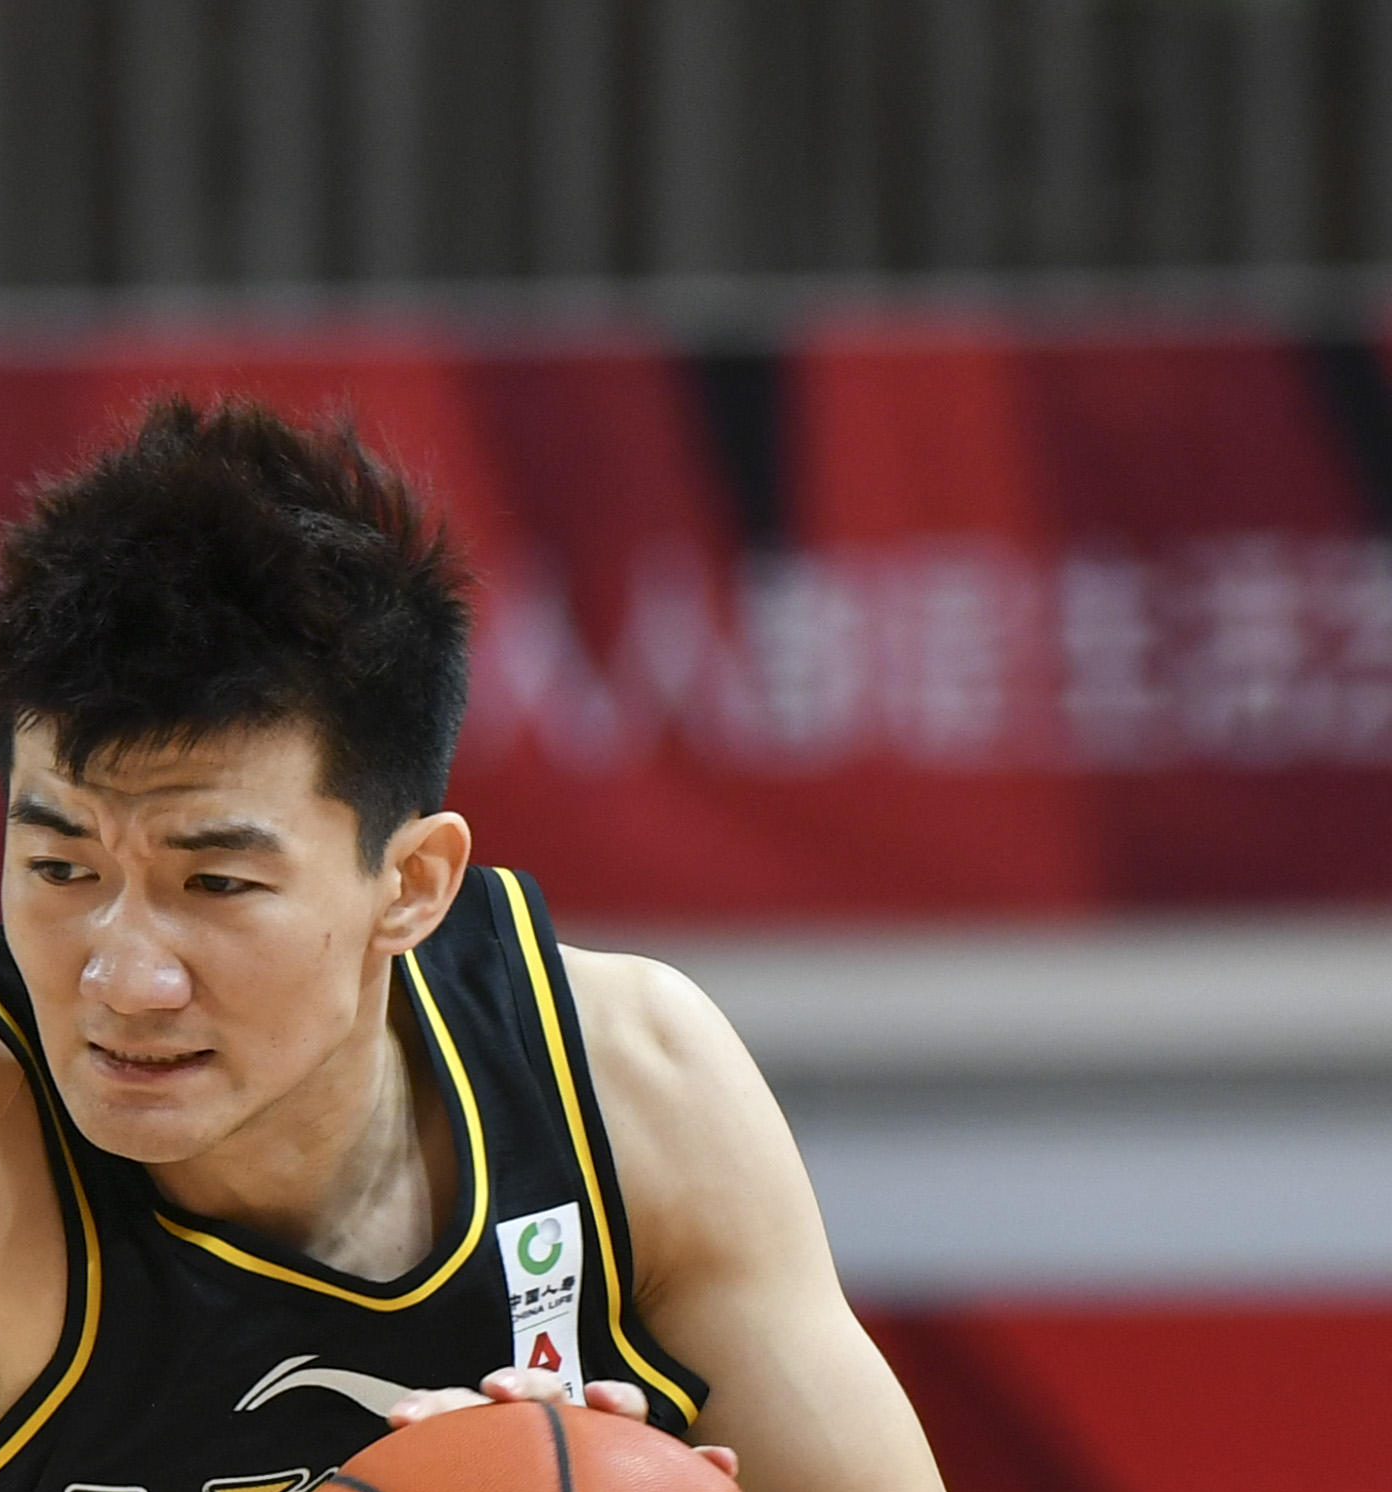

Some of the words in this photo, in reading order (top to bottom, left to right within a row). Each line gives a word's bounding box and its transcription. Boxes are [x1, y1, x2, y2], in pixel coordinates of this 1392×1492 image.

[509, 1274, 576, 1311] 中国人寿
[547, 1292, 575, 1311] LIFE
